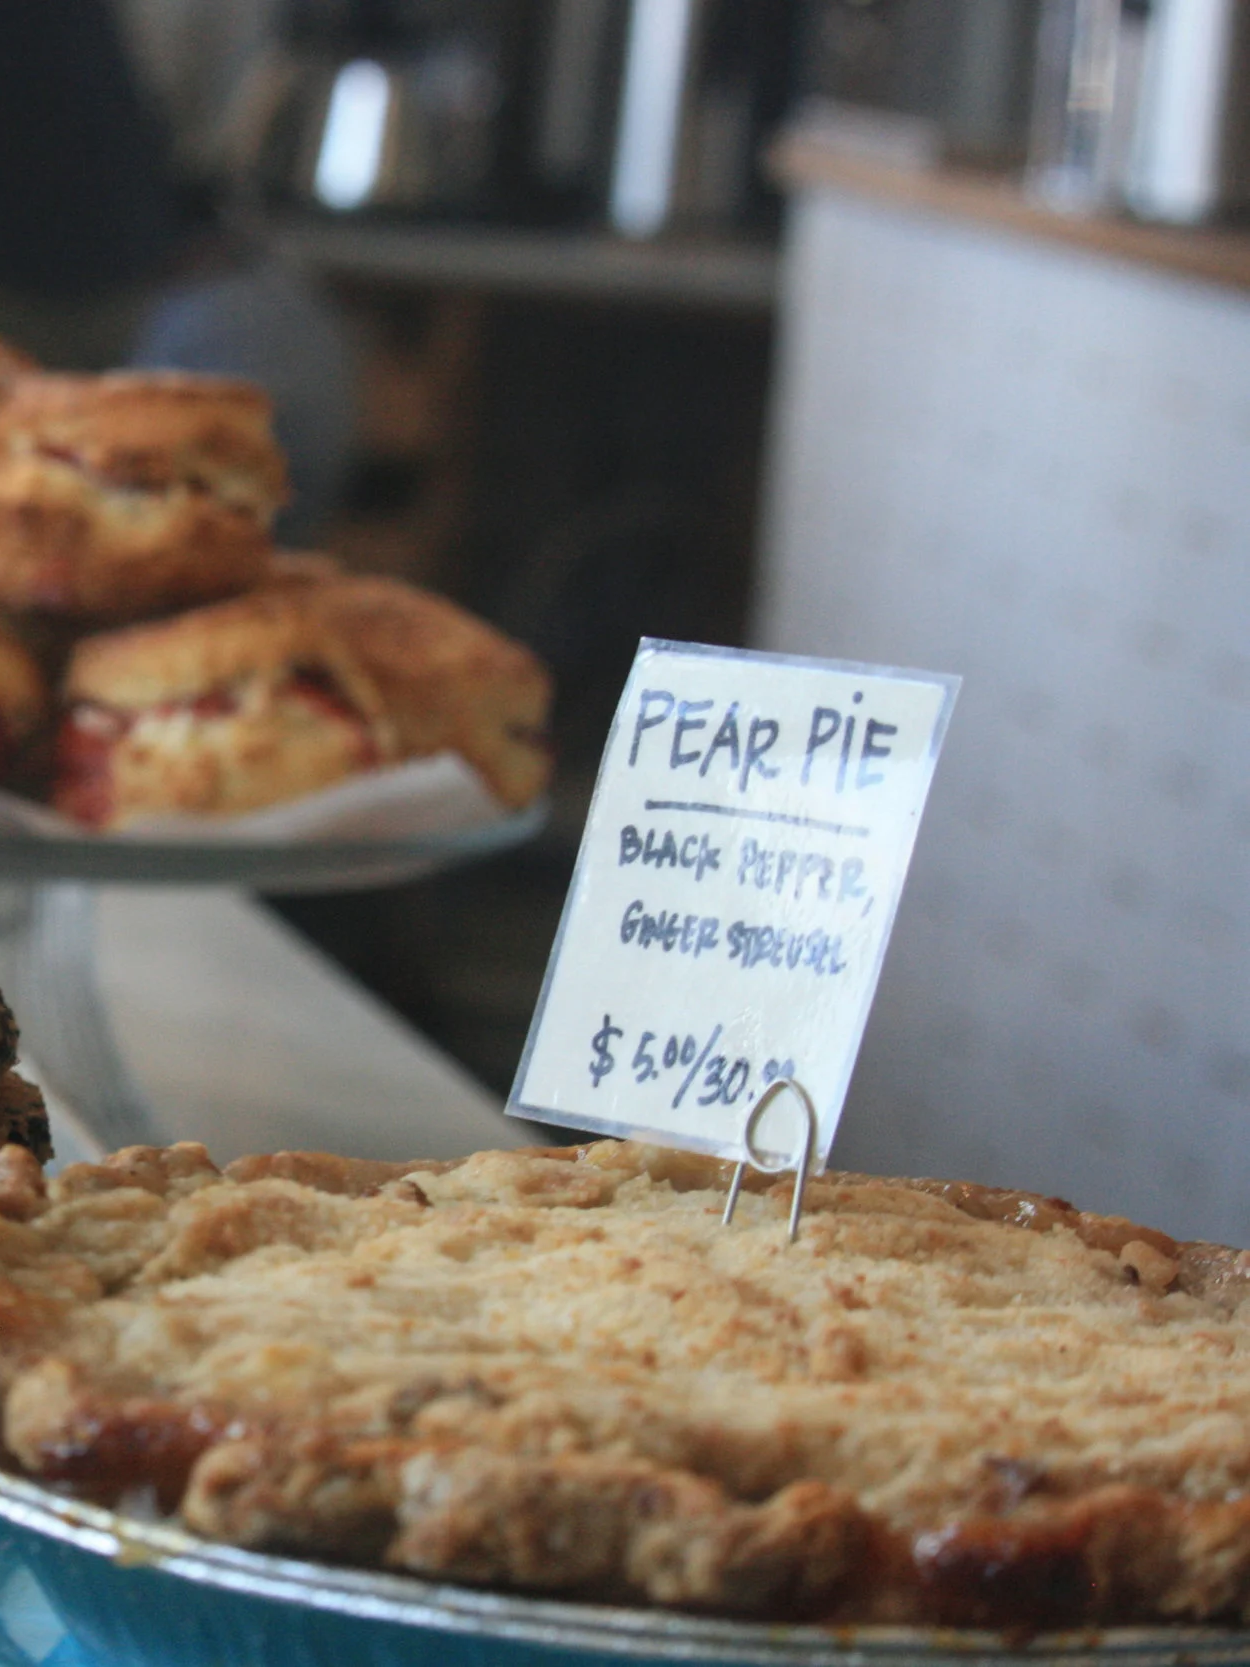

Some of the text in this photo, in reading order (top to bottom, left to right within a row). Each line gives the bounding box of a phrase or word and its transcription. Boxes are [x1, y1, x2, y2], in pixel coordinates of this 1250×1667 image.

[628, 688, 898, 794] PEAR PIE
[618, 824, 722, 882] BLACK
